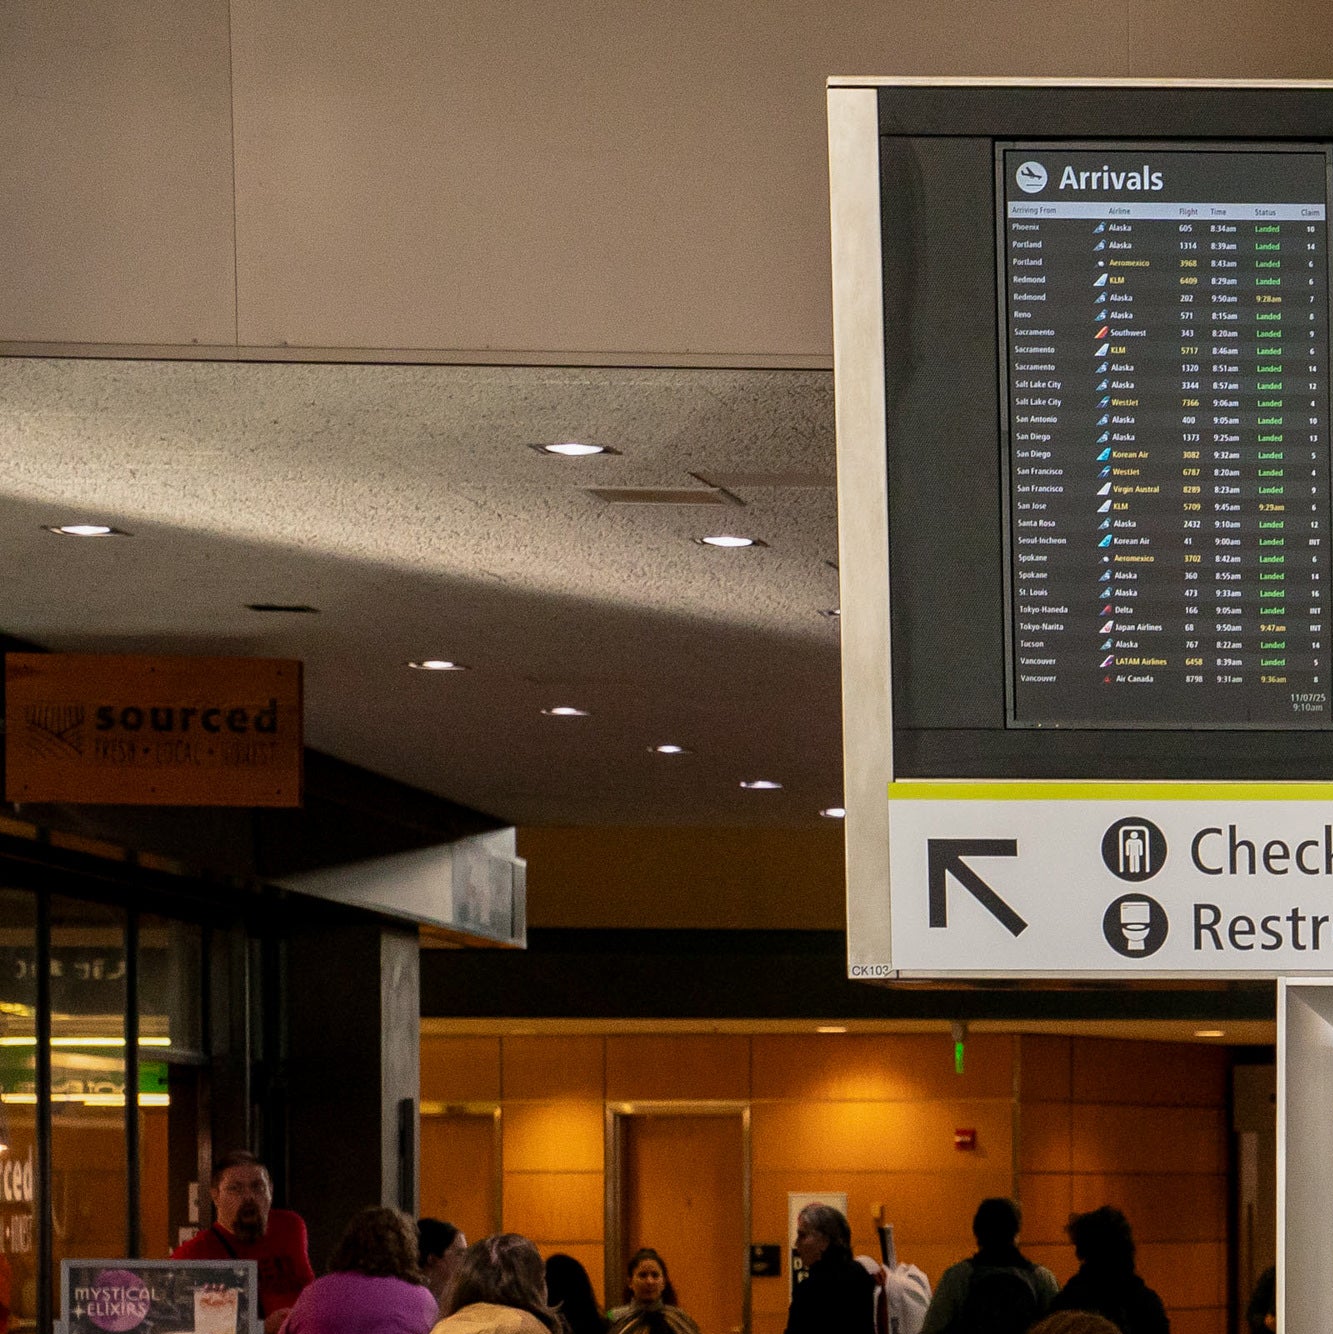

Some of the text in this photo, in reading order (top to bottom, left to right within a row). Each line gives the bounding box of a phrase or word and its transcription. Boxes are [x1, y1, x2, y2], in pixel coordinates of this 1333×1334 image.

[1059, 165, 1163, 191] Arrivals
[1012, 206, 1037, 215] Arriving
[1179, 208, 1198, 216] Flight
[1290, 693, 1325, 702] 11/07/25
[1293, 703, 1323, 712] 9:10am
[96, 699, 278, 734] sourced
[75, 1287, 160, 1300] MYSTICAL
[87, 1303, 146, 1316] ELIXIRS
